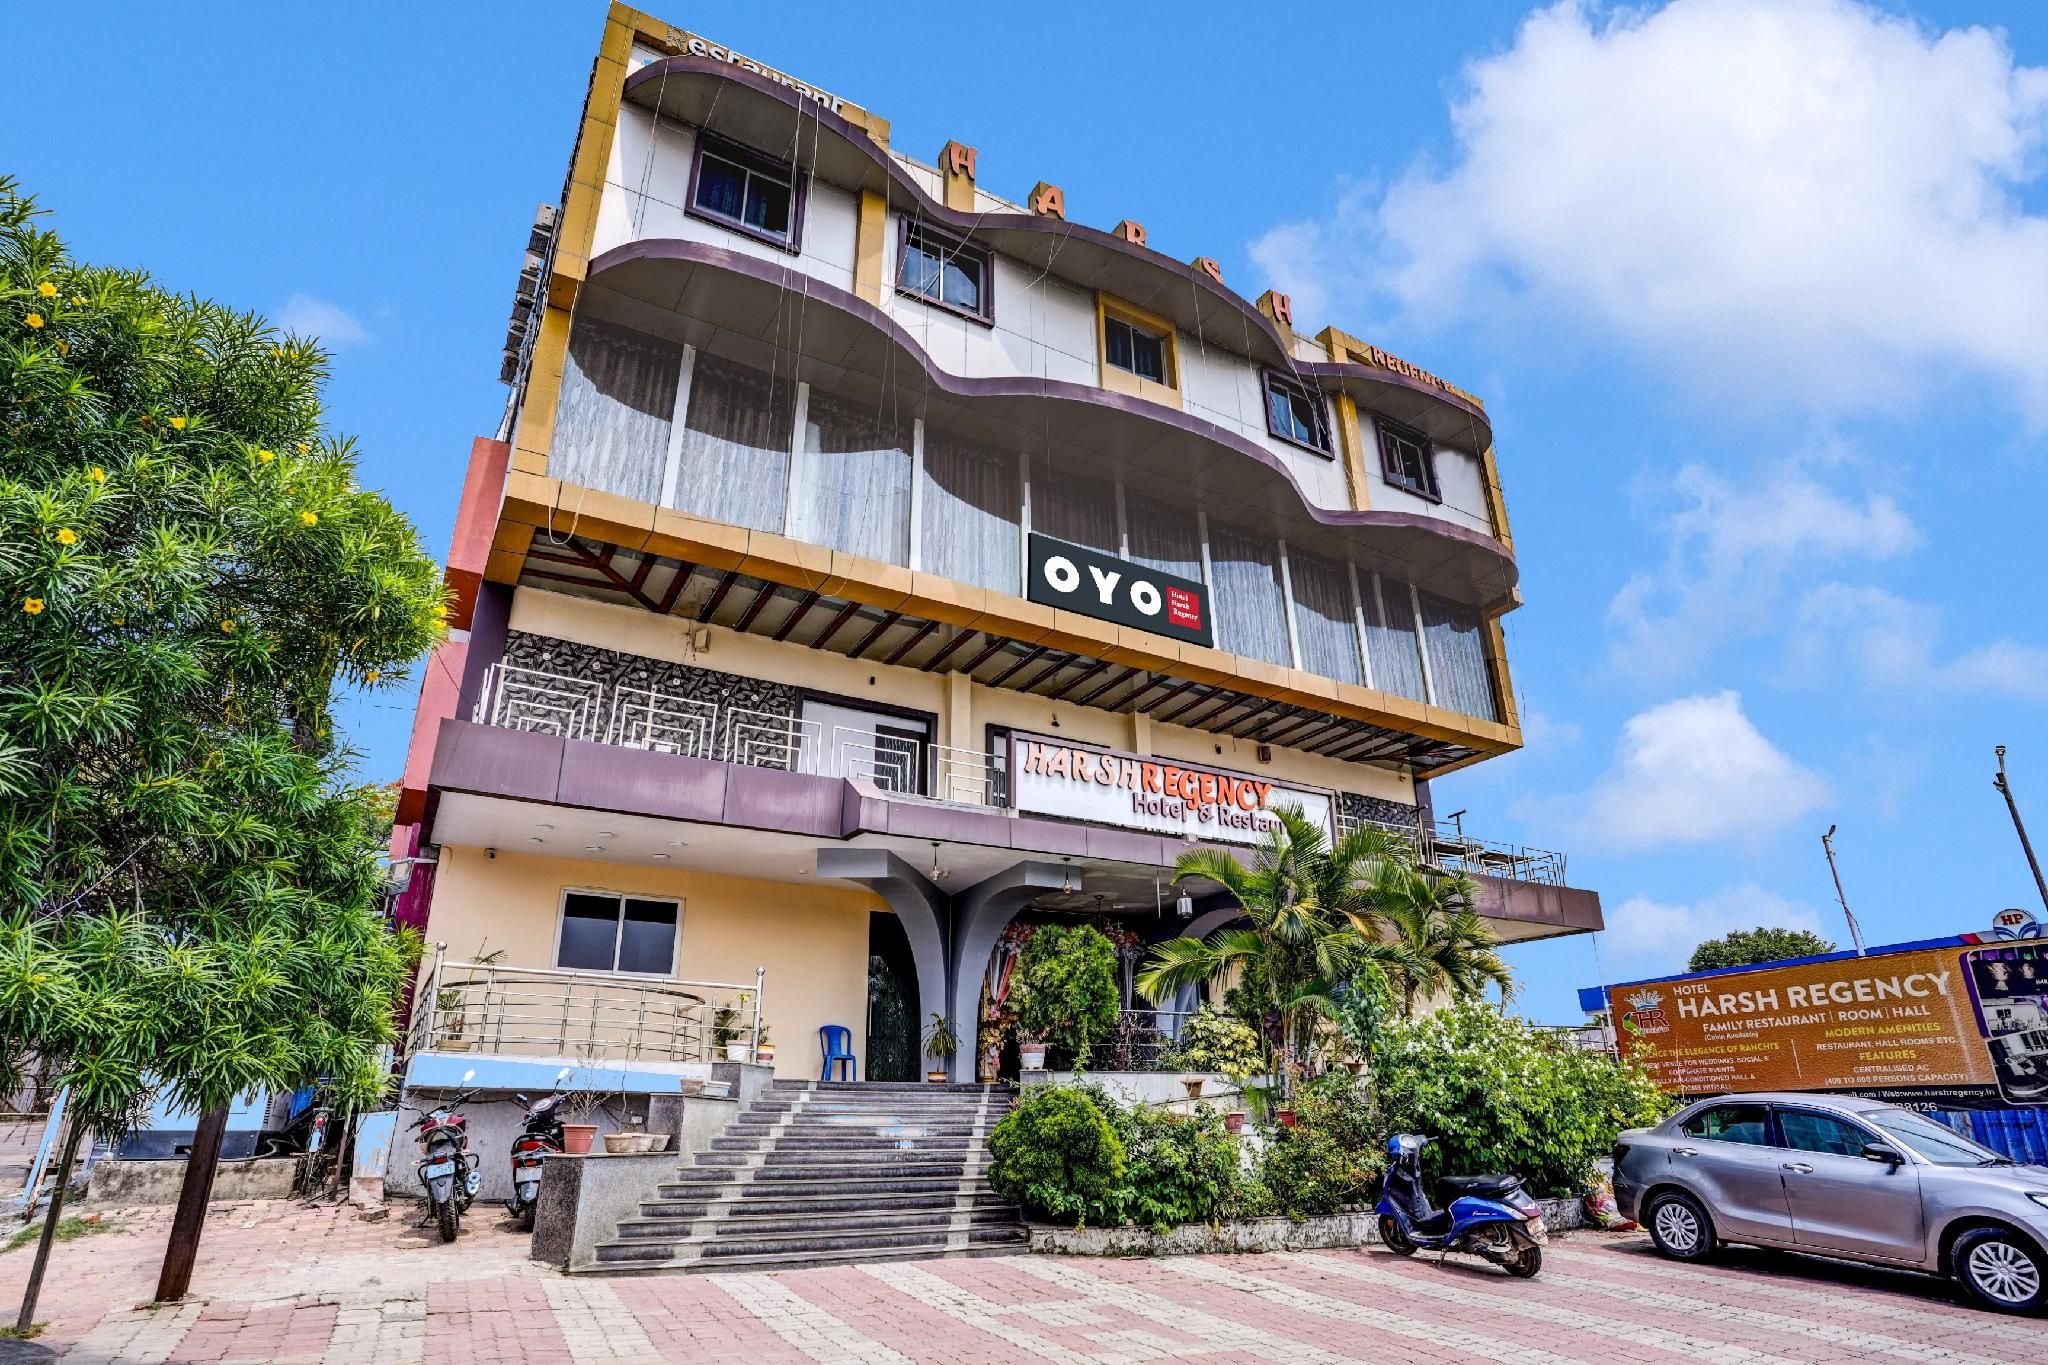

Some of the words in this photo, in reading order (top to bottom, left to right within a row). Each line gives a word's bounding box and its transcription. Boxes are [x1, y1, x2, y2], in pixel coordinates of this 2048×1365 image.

[1044, 555, 1162, 616] OYO
[1024, 741, 1137, 791] HARSH
[1140, 762, 1274, 811] REGENCY
[1132, 792, 1187, 822] Hotel
[1198, 802, 1214, 824] &
[2000, 913, 2024, 926] HP
[1673, 983, 1711, 996] HOTEL
[1677, 988, 1779, 1019] HARSH
[1786, 971, 1950, 1009] REGENCY
[1703, 1020, 1743, 1032] FAMILY
[1746, 1012, 1826, 1029] RESTAURANT
[1838, 1007, 1883, 1022] ROOM
[1892, 1005, 1931, 1018] HALL
[1825, 1027, 1875, 1038] MODERN
[1877, 1022, 1942, 1034] AMENITIES
[1900, 1037, 1934, 1046] ROOMS
[1669, 1049, 1683, 1057] THE
[1685, 1045, 1725, 1056] ELEGANCE
[1726, 1045, 1738, 1053] OF
[1859, 1049, 1917, 1061] FEATURES
[1853, 1064, 1914, 1073] CENTRALISED
[1916, 1064, 1930, 1072] AC
[1872, 1074, 1916, 1083] PERSONS
